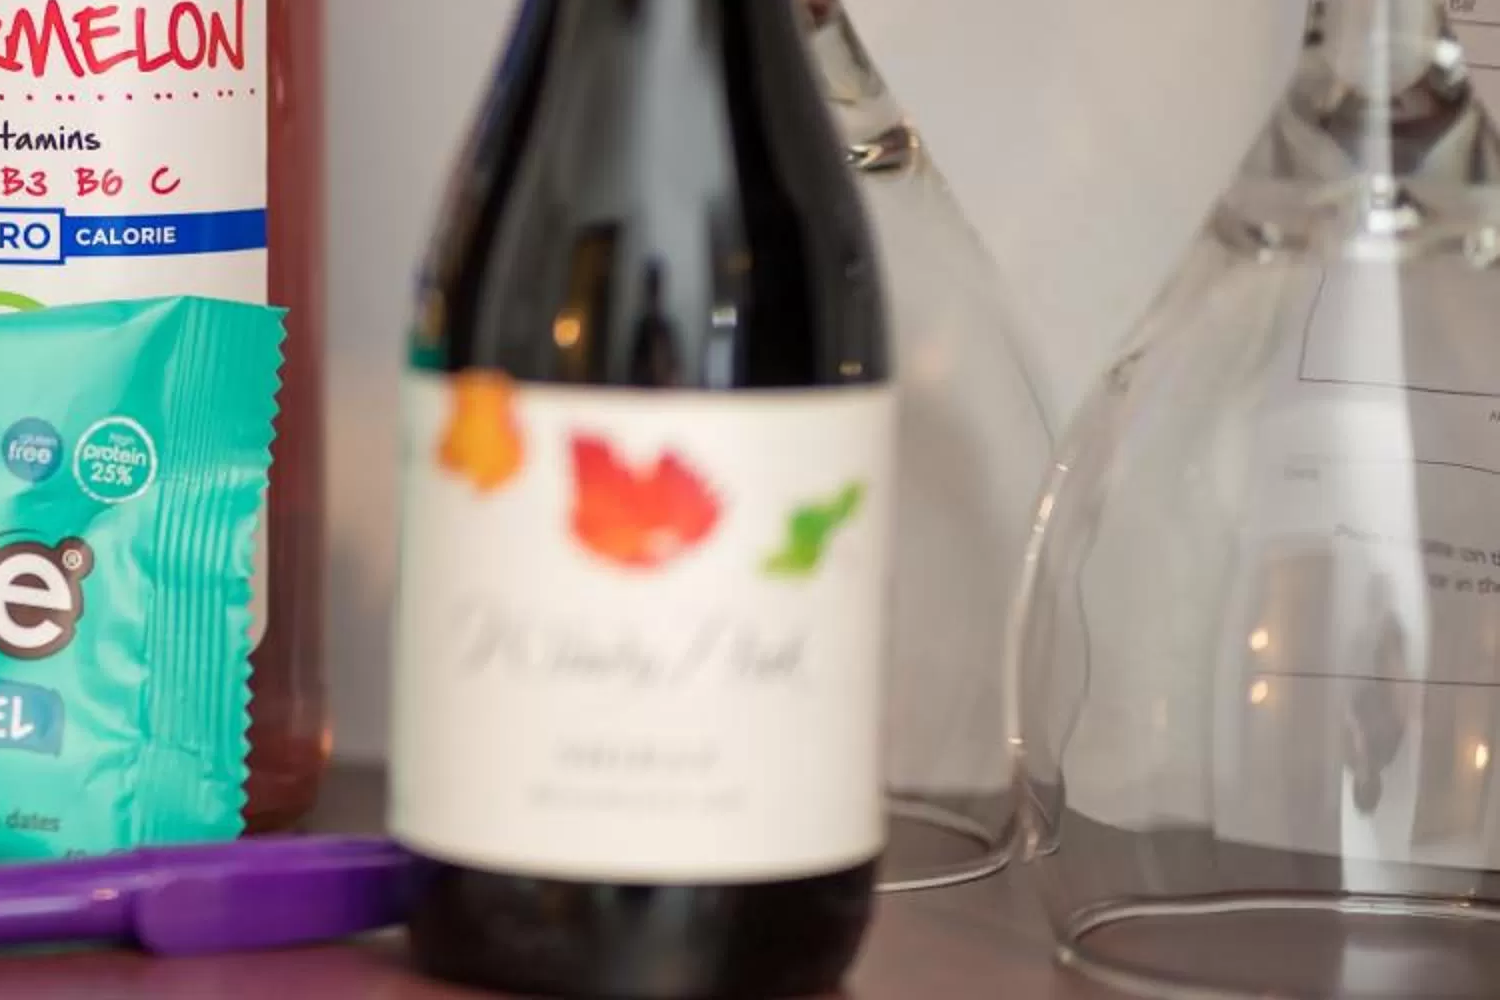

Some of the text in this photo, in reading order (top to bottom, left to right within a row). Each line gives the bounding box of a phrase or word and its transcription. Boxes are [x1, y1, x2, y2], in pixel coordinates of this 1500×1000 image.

[2, 166, 49, 197] B3
[75, 166, 124, 197] B6
[151, 165, 181, 196] C
[75, 224, 177, 246] CALORIE
[7, 440, 53, 465] free
[83, 443, 148, 468] protein
[90, 463, 134, 487] 25%
[4, 807, 61, 833] dates
